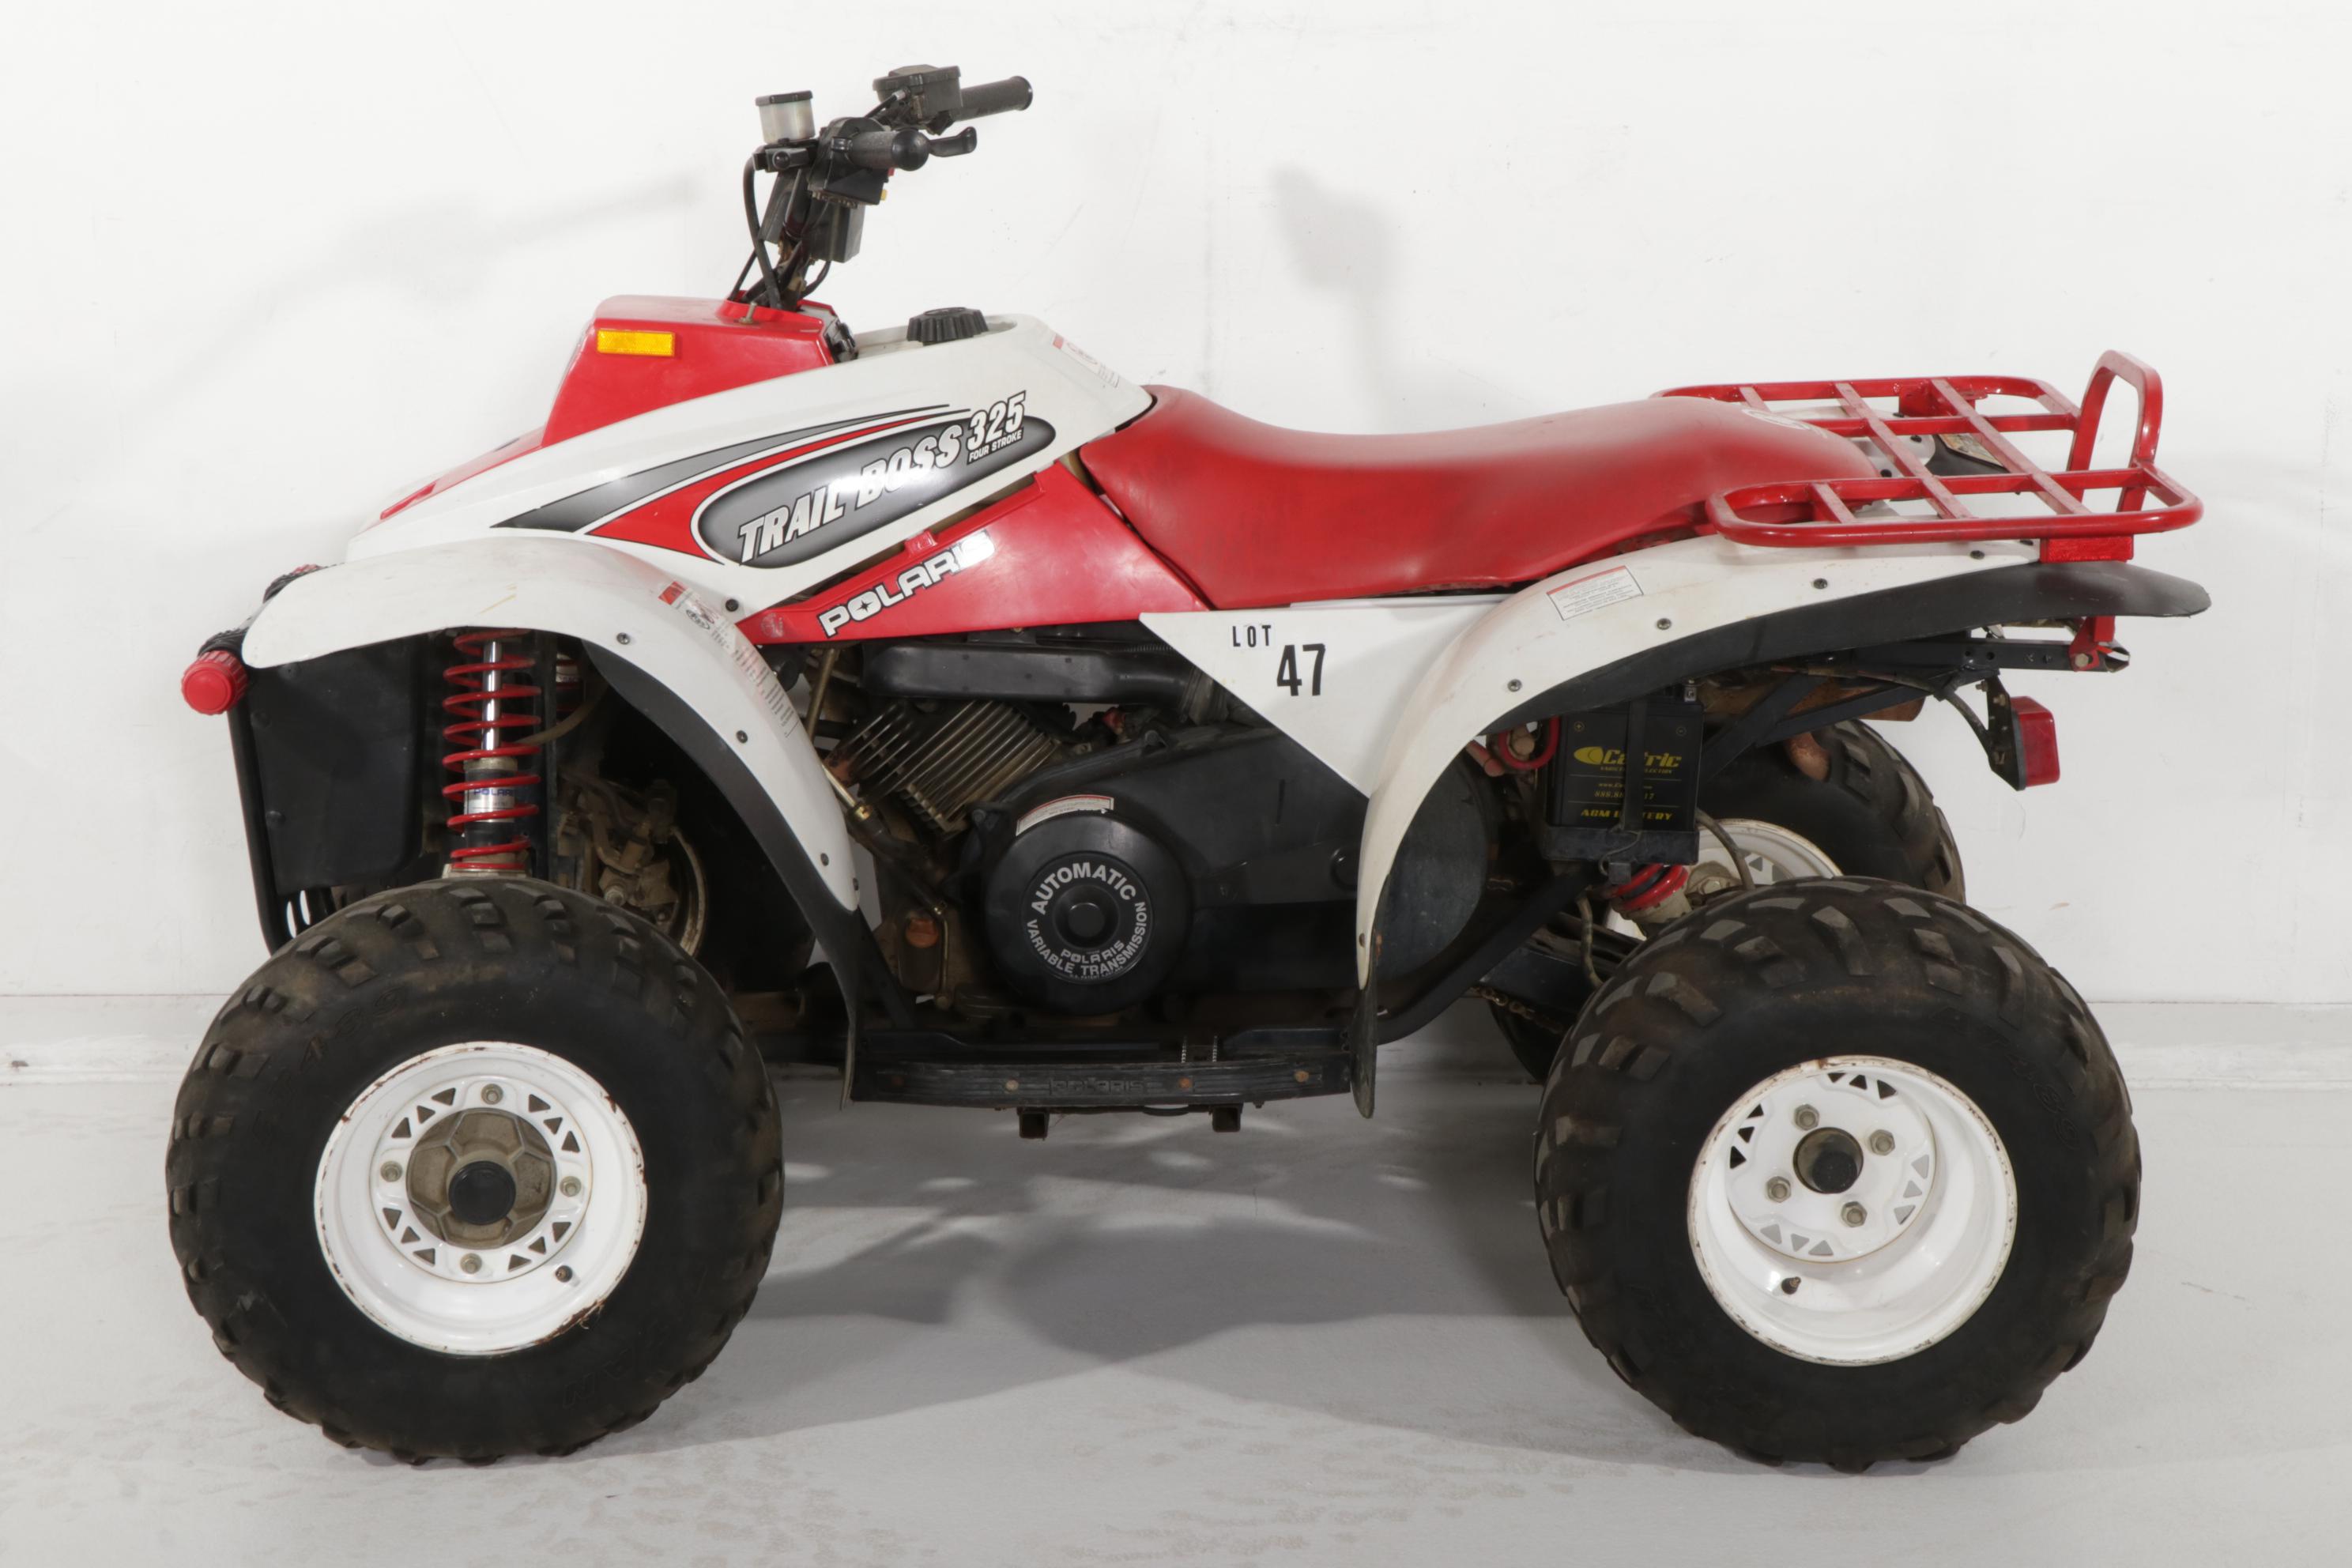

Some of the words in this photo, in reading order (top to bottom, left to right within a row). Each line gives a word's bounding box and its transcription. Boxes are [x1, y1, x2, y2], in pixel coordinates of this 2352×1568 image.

[968, 444, 989, 462] FOUR
[991, 429, 1023, 452] STROKE
[737, 481, 846, 565] TRAIL
[854, 424, 963, 511] BOSS
[967, 390, 1027, 451] 325
[817, 528, 996, 638] POLARI
[1232, 624, 1272, 647] LOT
[1276, 643, 1326, 696] 47
[1031, 861, 1136, 915] AUTOMATIC
[1027, 918, 1075, 974] VARIABLE
[1080, 901, 1148, 976] TRANSMISSION
[1060, 940, 1125, 964] POLARIS
